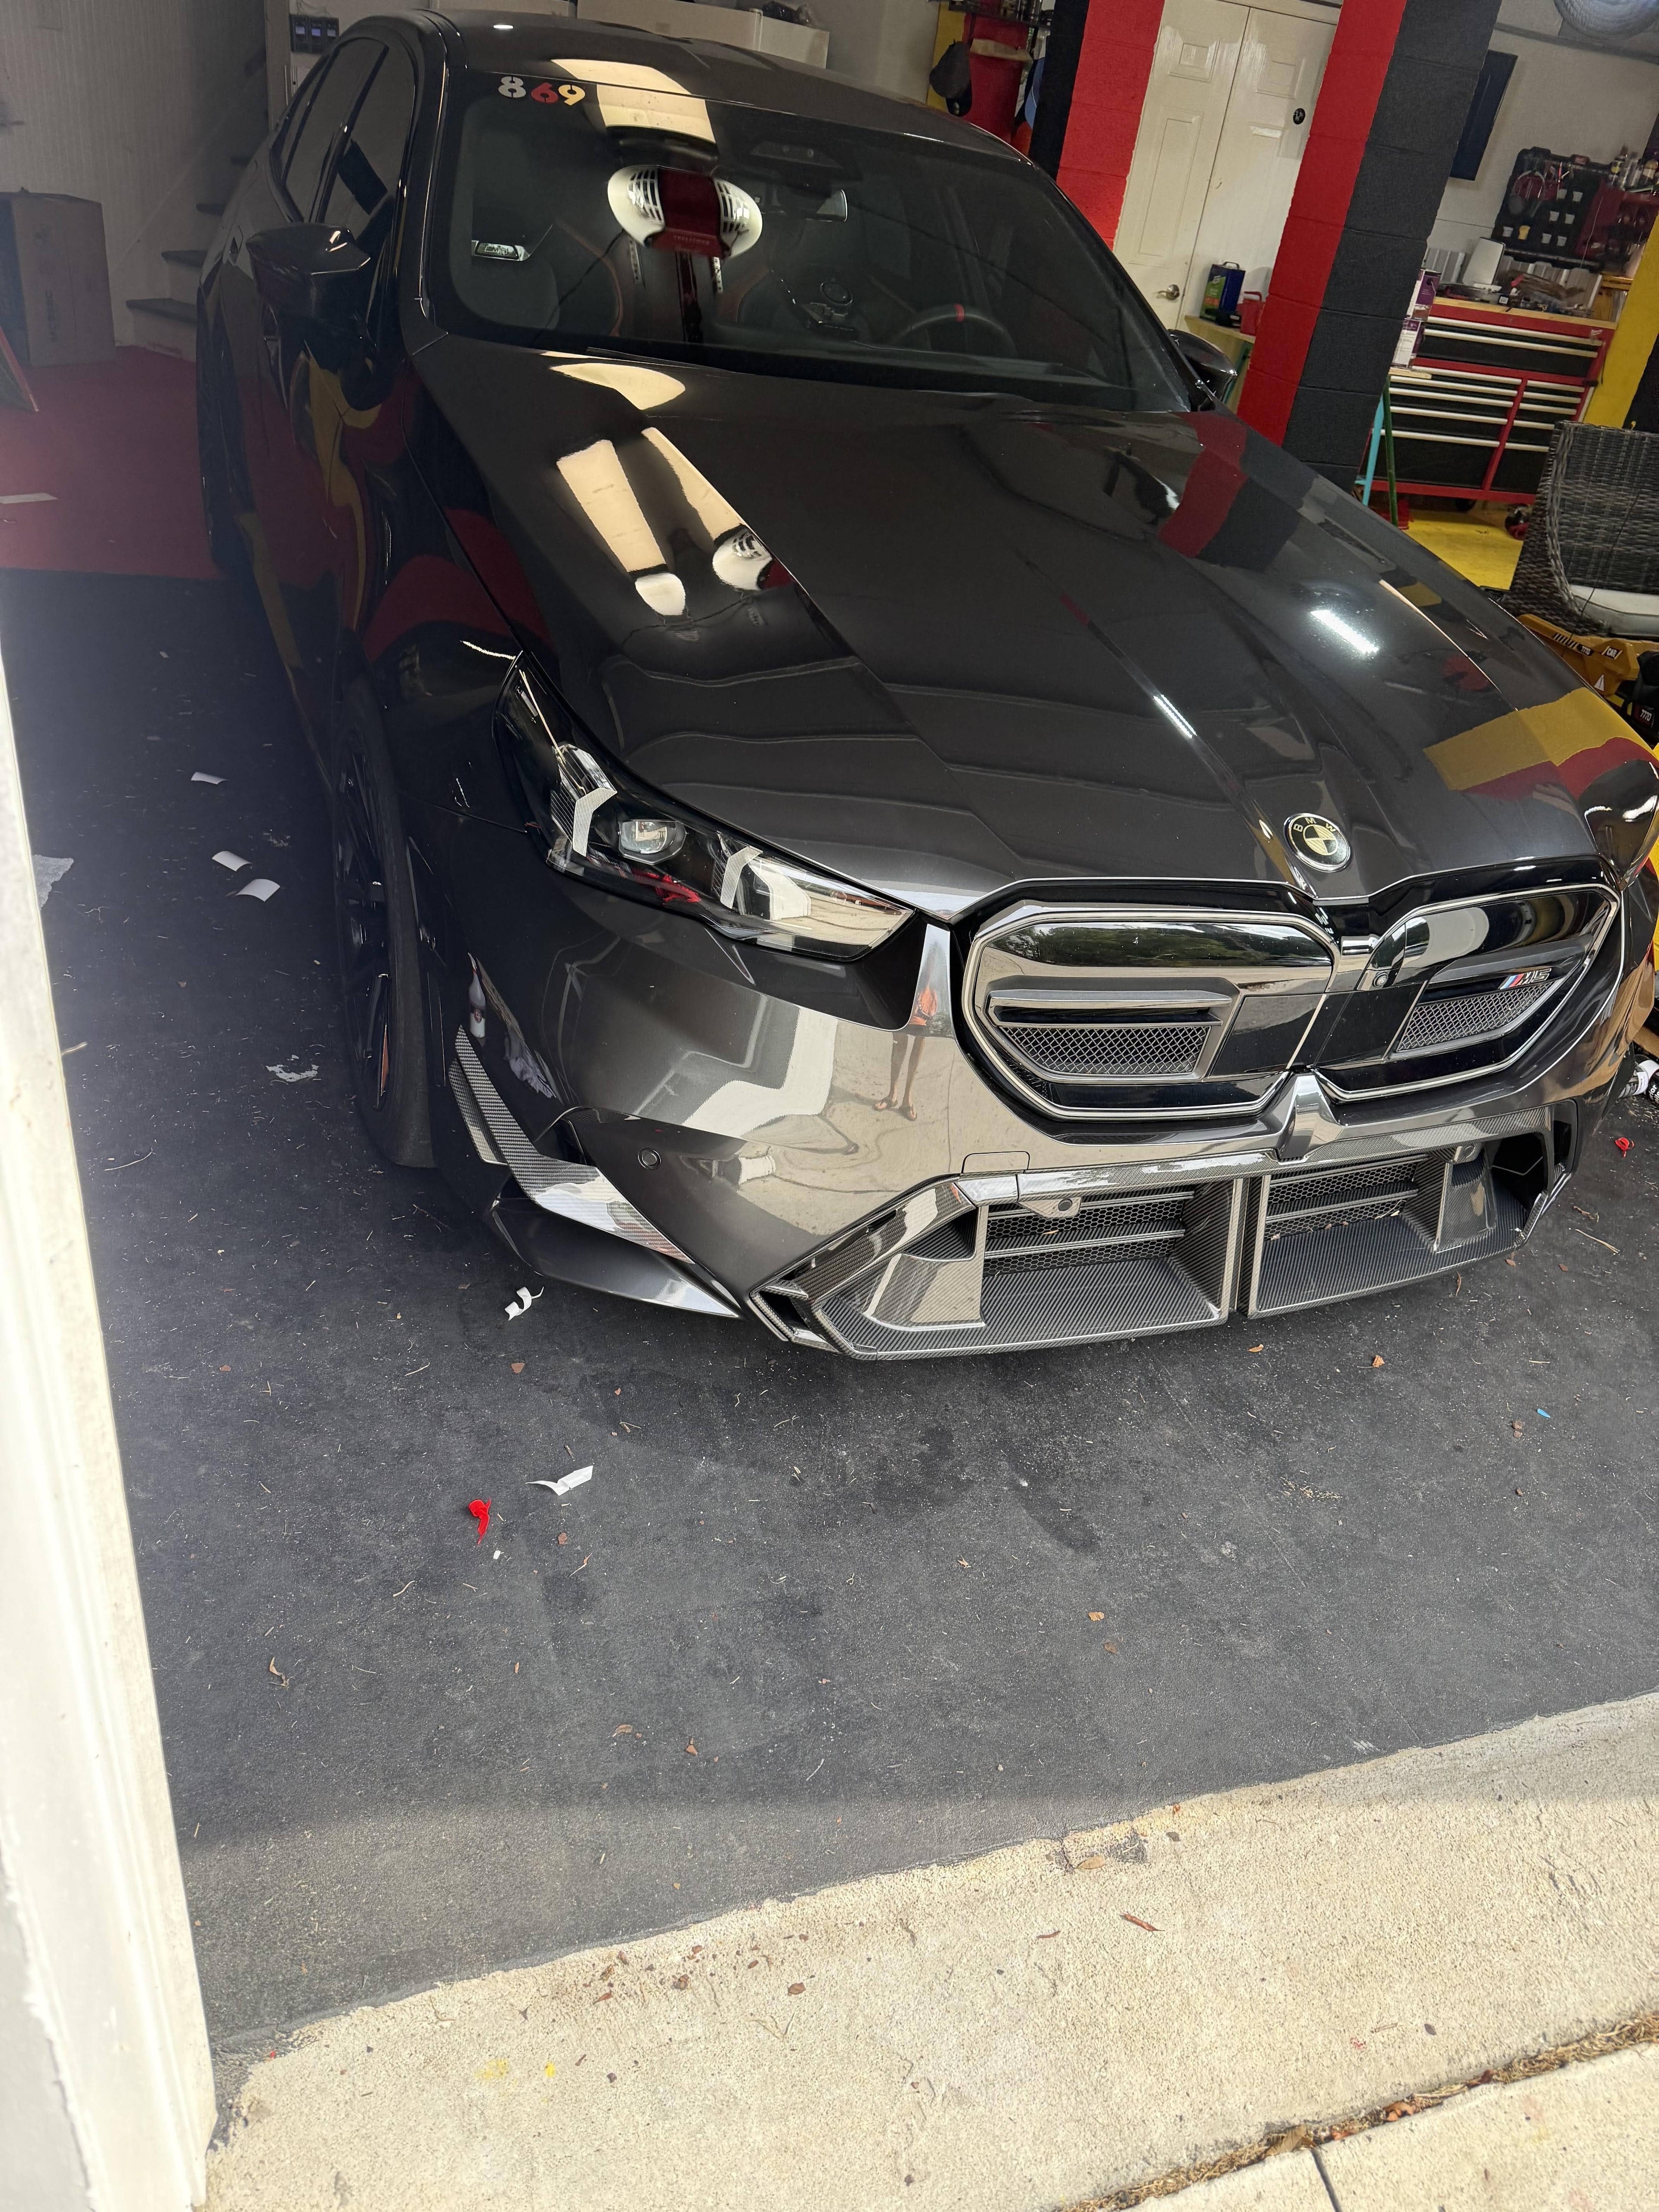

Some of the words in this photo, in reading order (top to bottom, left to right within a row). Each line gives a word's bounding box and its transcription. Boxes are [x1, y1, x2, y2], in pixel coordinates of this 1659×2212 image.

[498, 76, 586, 106] 869
[1293, 817, 1336, 833] BMW
[1515, 968, 1552, 986] M5
